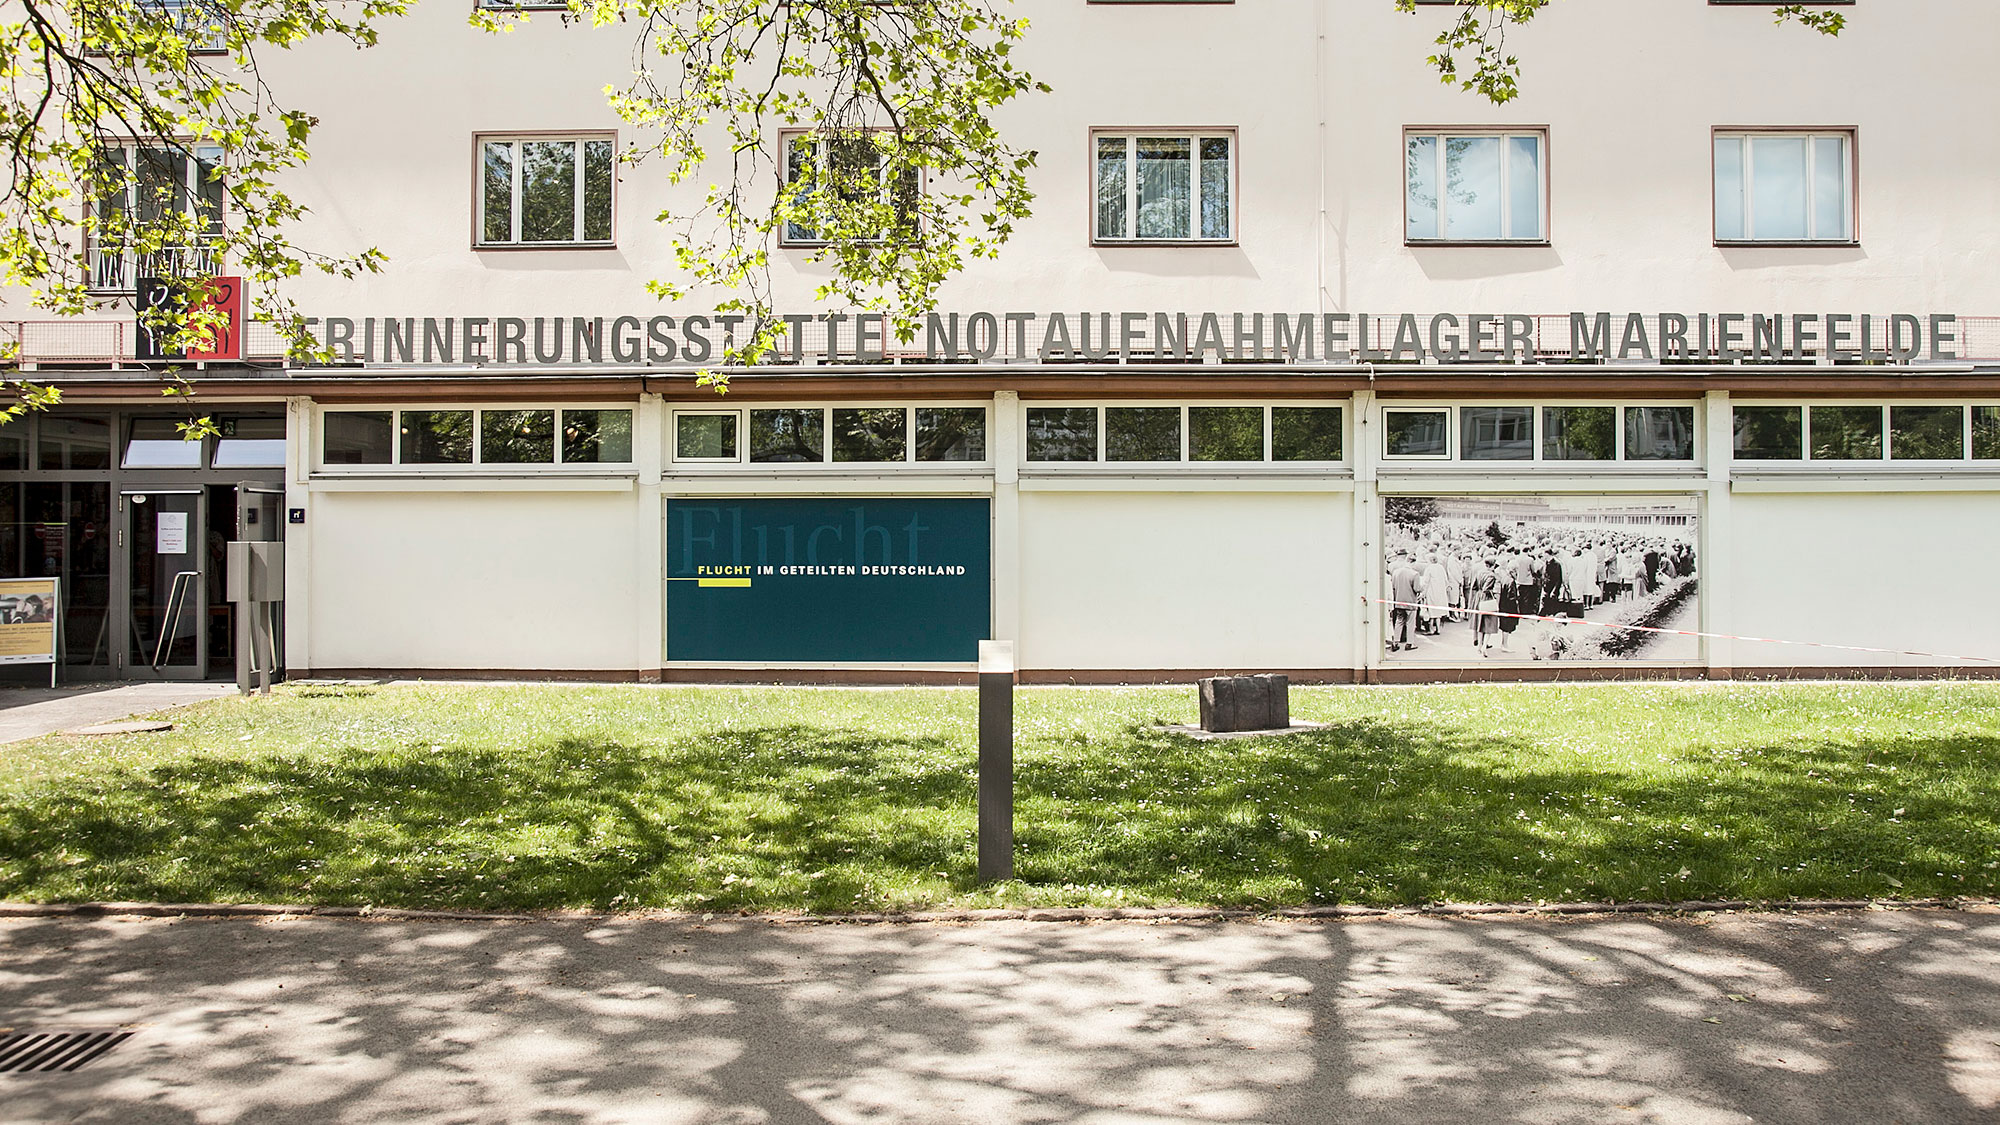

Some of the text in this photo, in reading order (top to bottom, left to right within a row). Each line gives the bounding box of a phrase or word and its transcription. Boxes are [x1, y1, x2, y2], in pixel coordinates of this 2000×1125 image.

[927, 311, 1534, 361] NOTAUFNAHMELAGER
[1569, 312, 1956, 361] MARIENFELDE
[675, 506, 929, 575] Flucht
[698, 565, 966, 576] FLUCHT IM GETEILTEN DEUTSCHLAND
